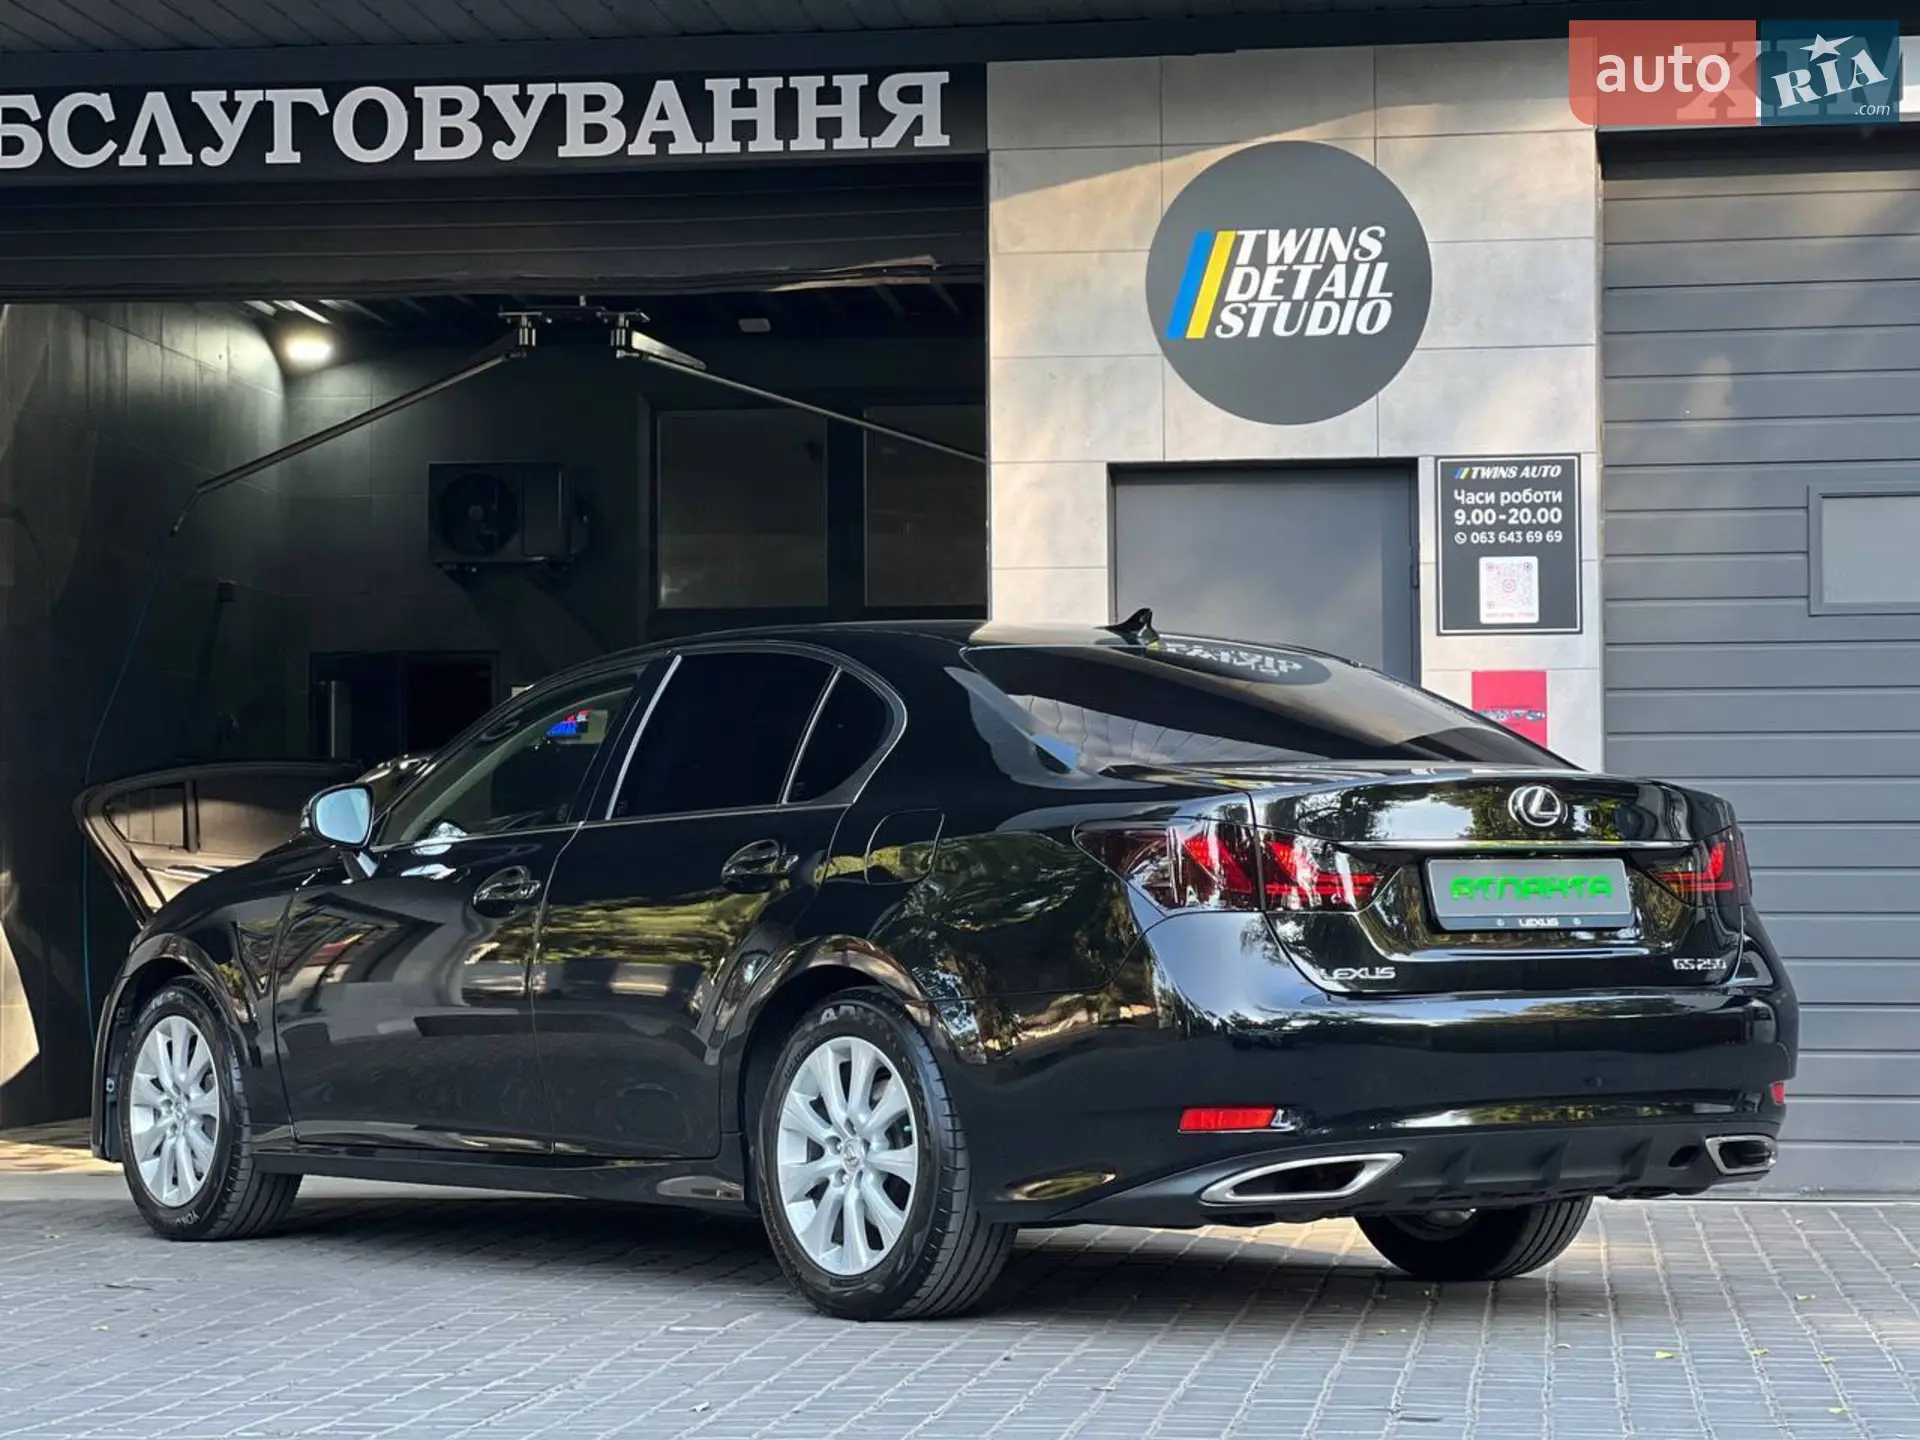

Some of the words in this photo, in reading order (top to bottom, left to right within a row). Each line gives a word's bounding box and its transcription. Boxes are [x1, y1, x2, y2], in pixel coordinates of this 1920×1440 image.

[0, 71, 950, 168] БСЛУГОВУВАННЯ
[1236, 226, 1386, 265] TWINS
[1224, 262, 1394, 302] DETAIL
[1215, 299, 1393, 338] STUDIO
[1471, 466, 1518, 480] TWINS
[1520, 465, 1562, 478] AUTO
[1453, 489, 1496, 505] Часи
[1500, 488, 1563, 506] роботи
[1470, 531, 1495, 544] 063
[1498, 531, 1523, 544] 643
[1526, 531, 1542, 543] 69
[1546, 530, 1563, 543] 69
[1518, 917, 1560, 928] LEXUS
[1320, 966, 1396, 981] LEXUS
